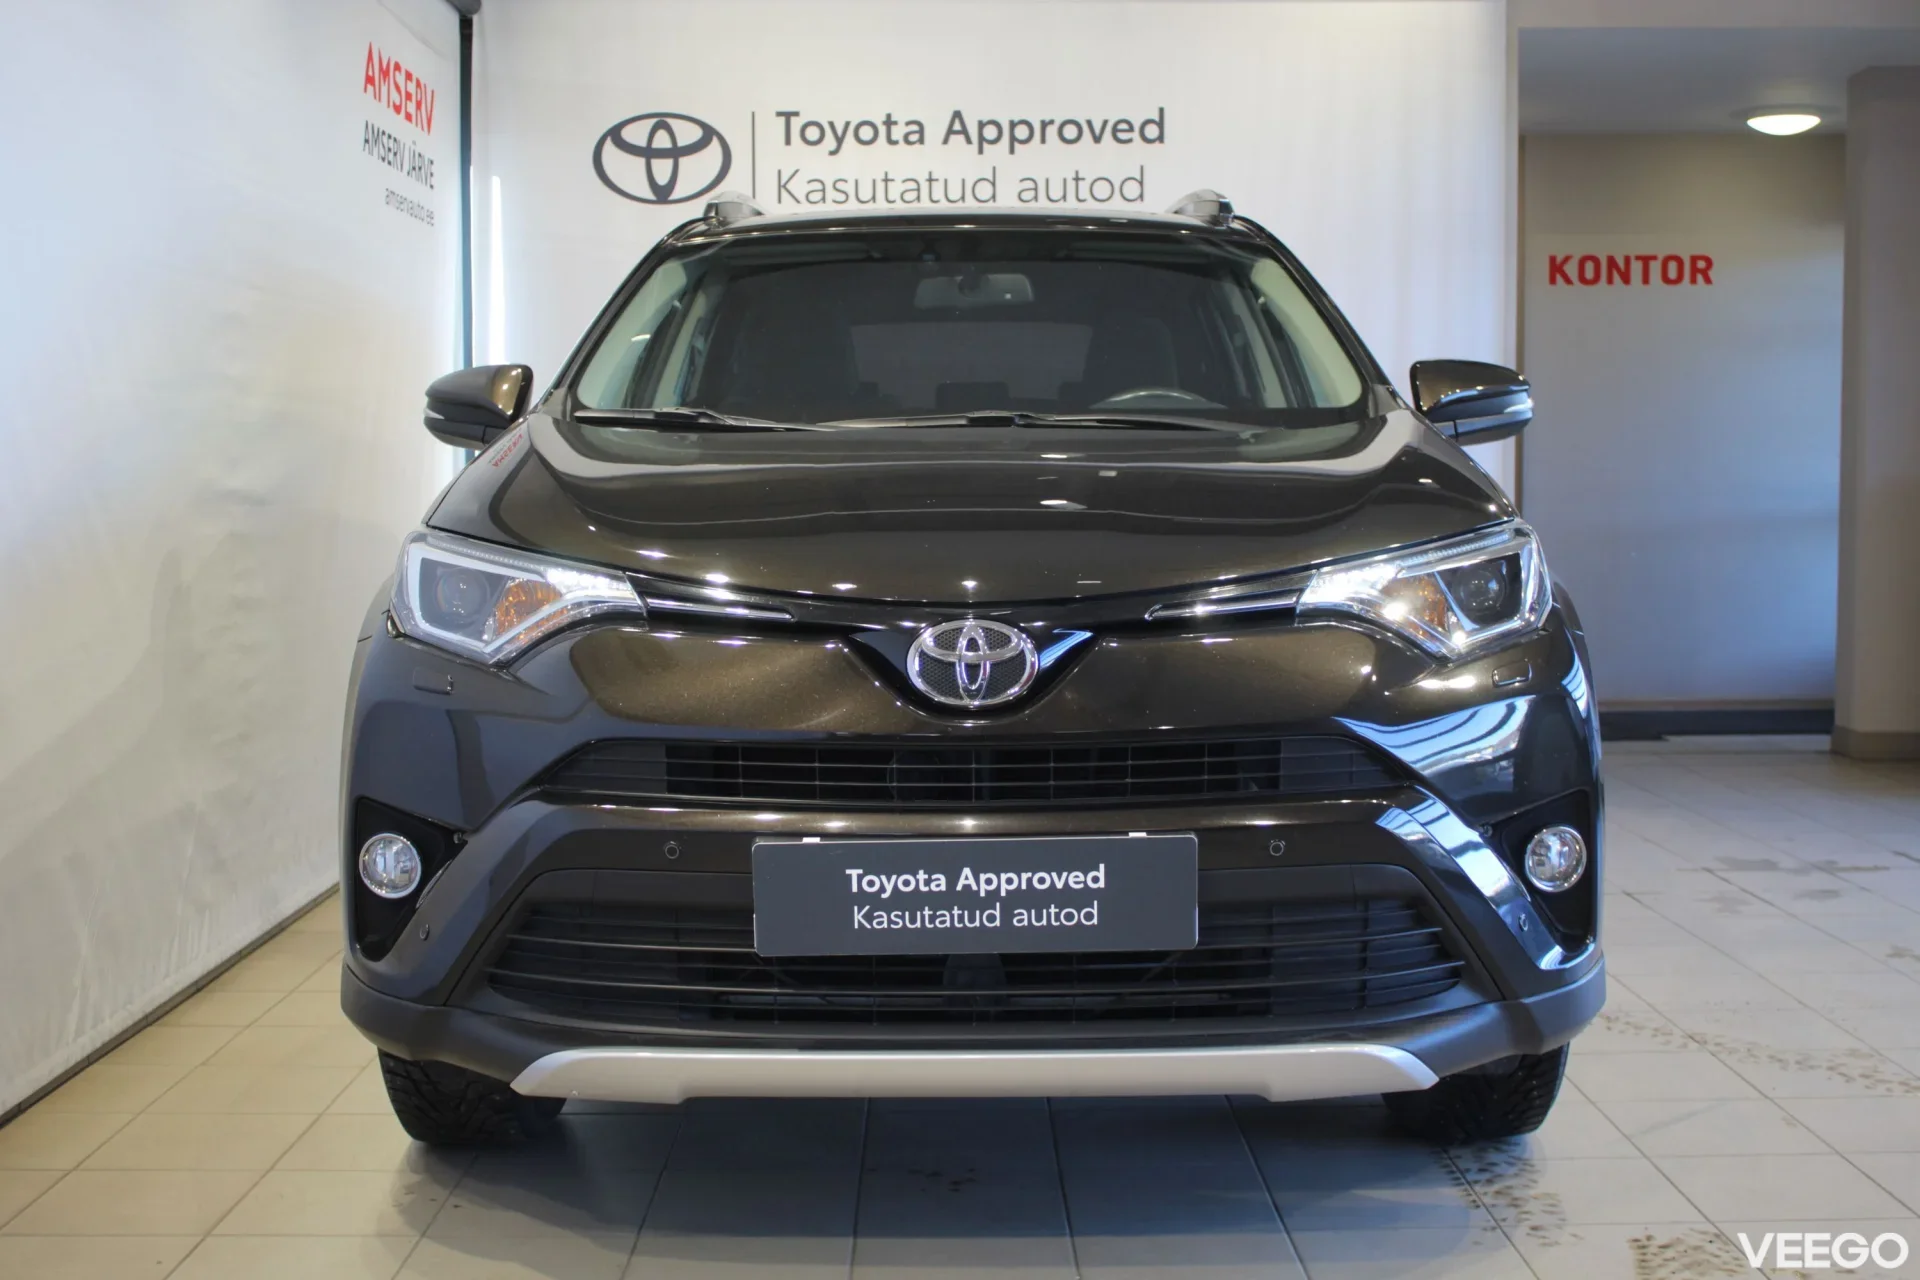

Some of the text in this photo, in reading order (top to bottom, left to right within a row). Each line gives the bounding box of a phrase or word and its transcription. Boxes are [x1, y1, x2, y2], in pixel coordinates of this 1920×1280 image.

[363, 41, 435, 136] AMSERV
[776, 107, 1166, 156] Toyota Approved
[363, 120, 434, 189] AMSERV JÄRVE
[776, 165, 1146, 205] Kasutatud autod
[385, 188, 434, 226] amservauto.ee
[1548, 254, 1714, 286] KONTOR
[845, 863, 1106, 898] Toyota Approved
[852, 901, 1099, 930] Kasutatud autod
